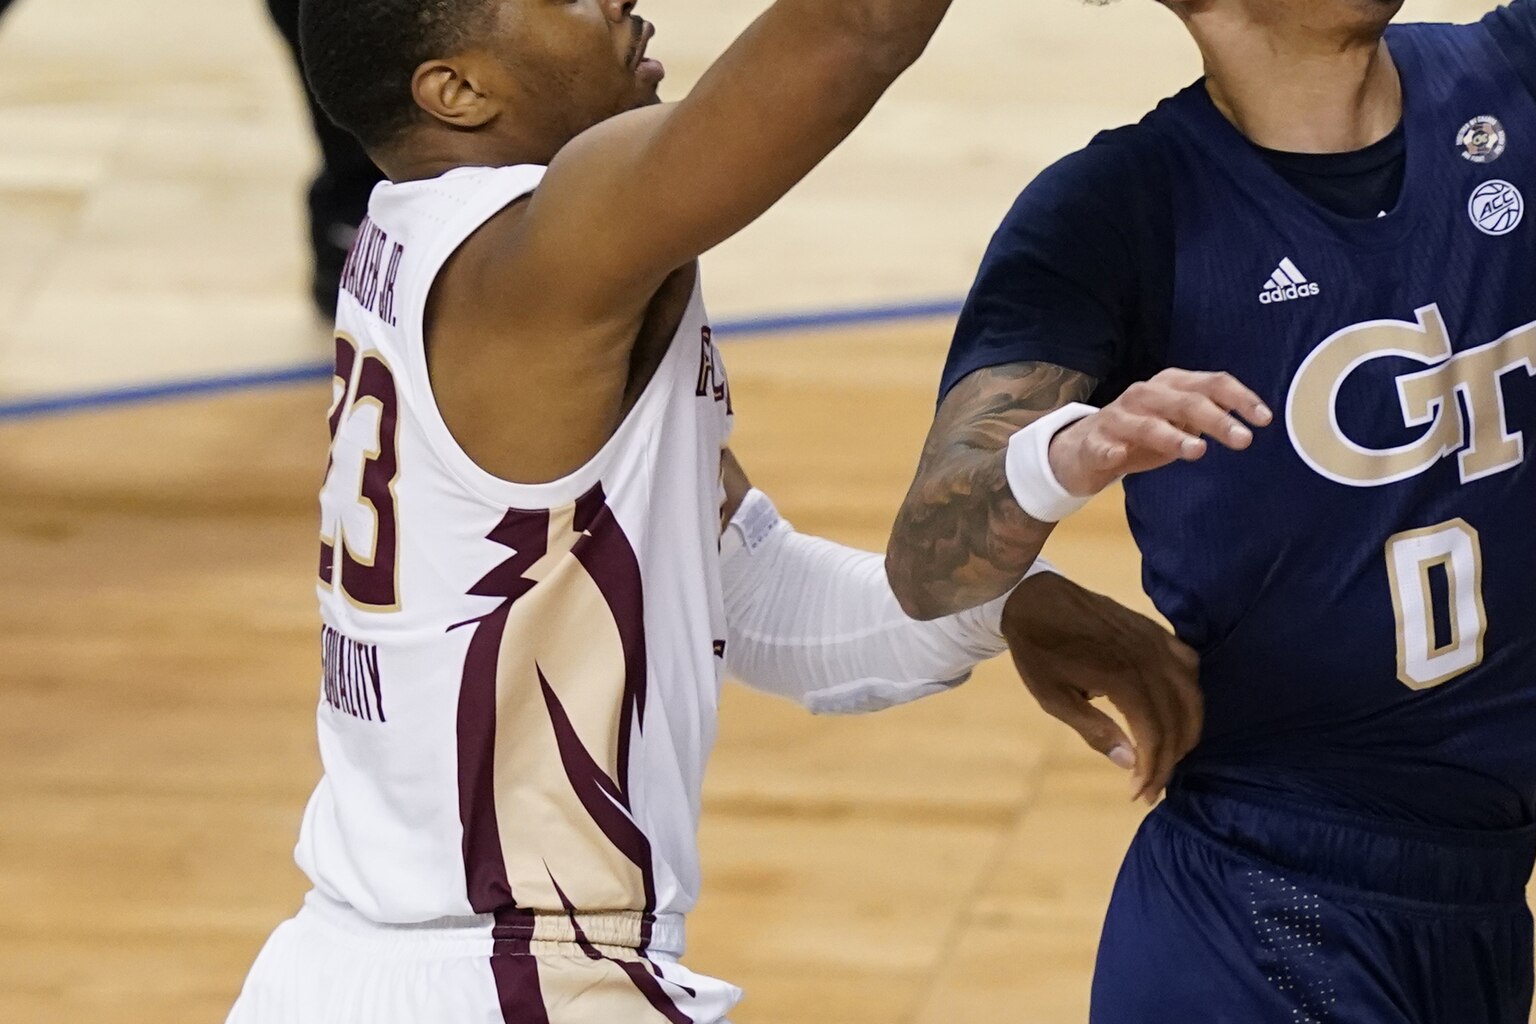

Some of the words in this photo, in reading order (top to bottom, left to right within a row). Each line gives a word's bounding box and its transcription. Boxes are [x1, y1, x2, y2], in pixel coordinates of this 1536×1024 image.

[1480, 189, 1514, 219] ACC
[379, 242, 403, 327] JR.
[1259, 281, 1320, 304] adidas
[1385, 517, 1488, 692] 0
